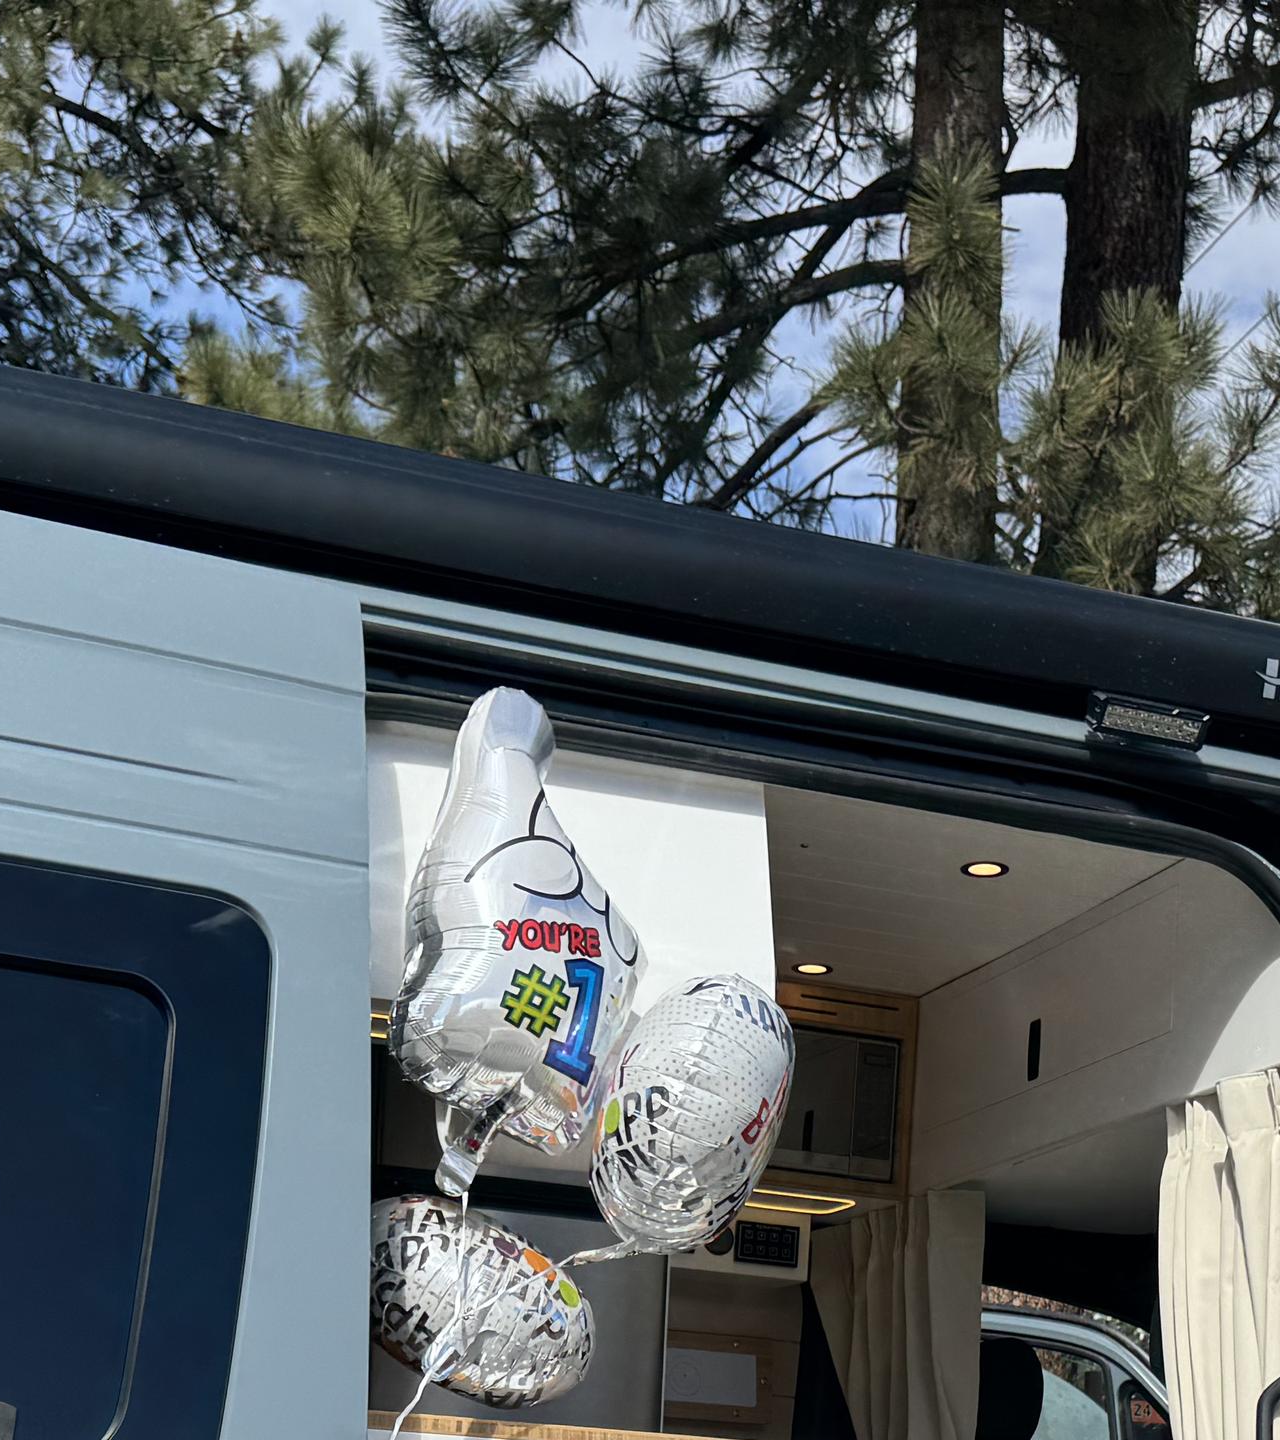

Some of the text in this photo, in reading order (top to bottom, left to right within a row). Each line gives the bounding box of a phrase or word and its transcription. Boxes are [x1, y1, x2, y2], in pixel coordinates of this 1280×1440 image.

[495, 918, 602, 958] YOU'RE
[500, 958, 605, 1088] #1
[1135, 1404, 1151, 1417] 24
